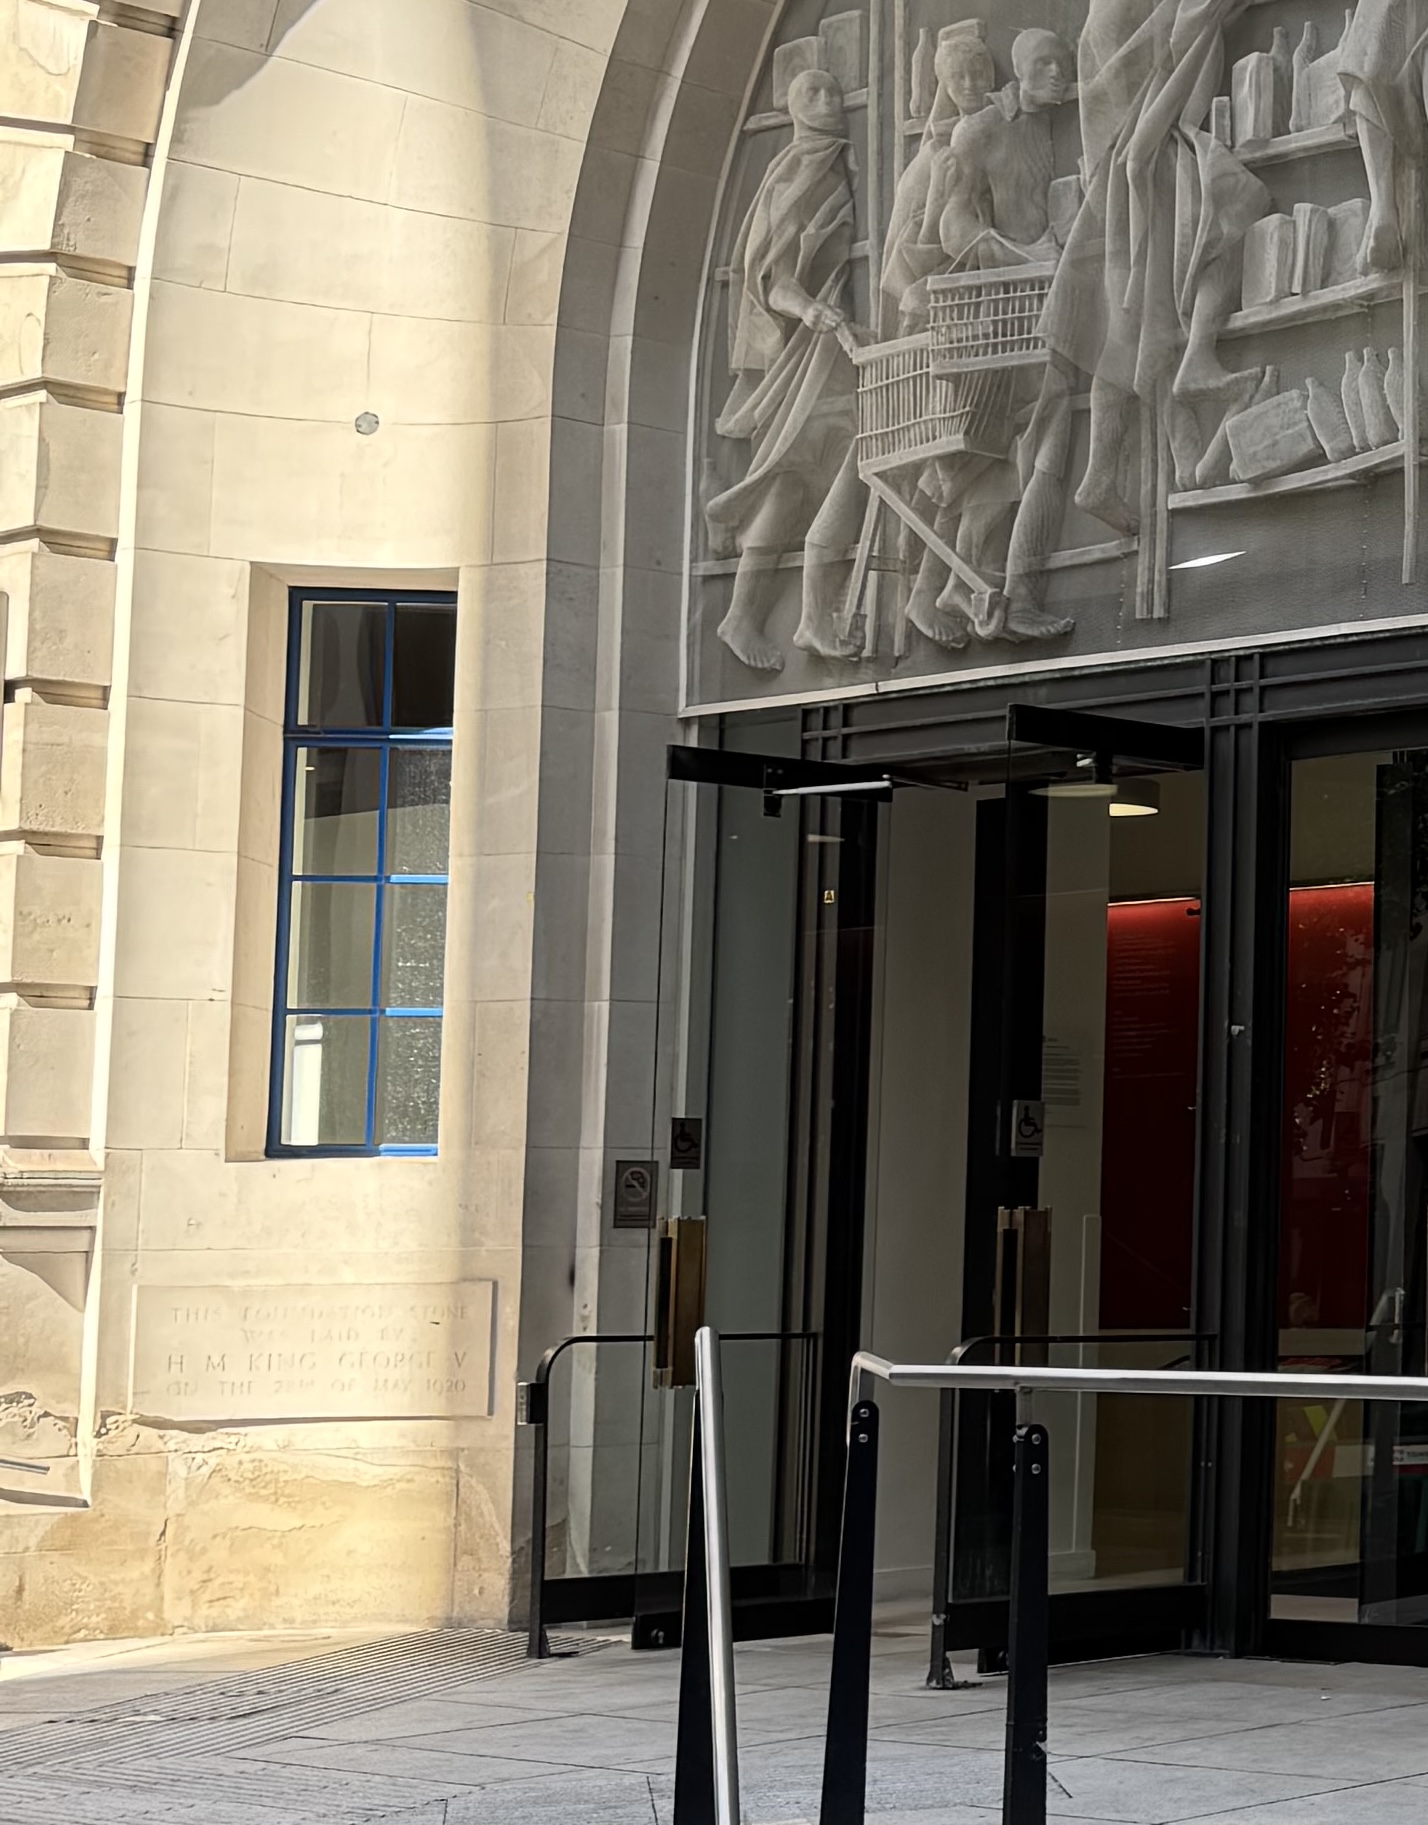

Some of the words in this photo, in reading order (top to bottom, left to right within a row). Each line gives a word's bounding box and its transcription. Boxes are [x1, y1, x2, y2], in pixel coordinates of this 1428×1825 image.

[167, 1353, 185, 1373] H
[205, 1353, 227, 1373] M
[248, 1351, 318, 1373] KING
[453, 1350, 468, 1370] V
[425, 1376, 467, 1394] 1920
